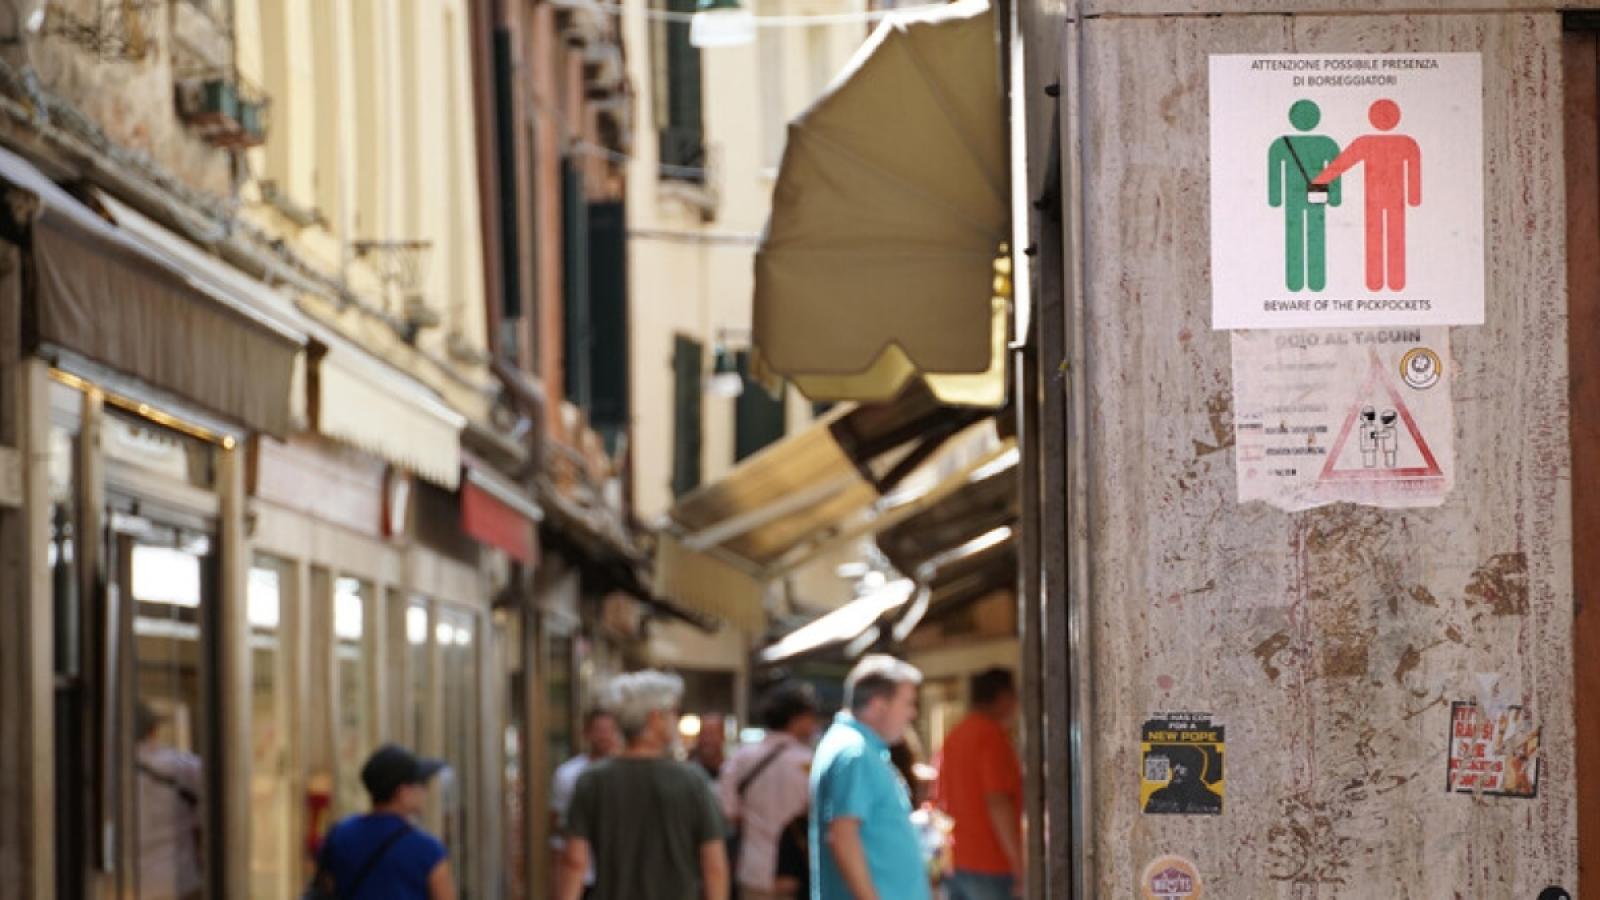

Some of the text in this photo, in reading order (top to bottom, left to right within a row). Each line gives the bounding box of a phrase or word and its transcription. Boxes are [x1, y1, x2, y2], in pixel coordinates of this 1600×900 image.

[1251, 58, 1439, 70] ATTENZIONE POSSIBILE PRESENZA
[1293, 75, 1397, 86] DI BORSEGGIATORI
[1264, 299, 1431, 311] BEWARE OF THE PICKPOCKETS
[1148, 731, 1217, 741] NEW POPE
